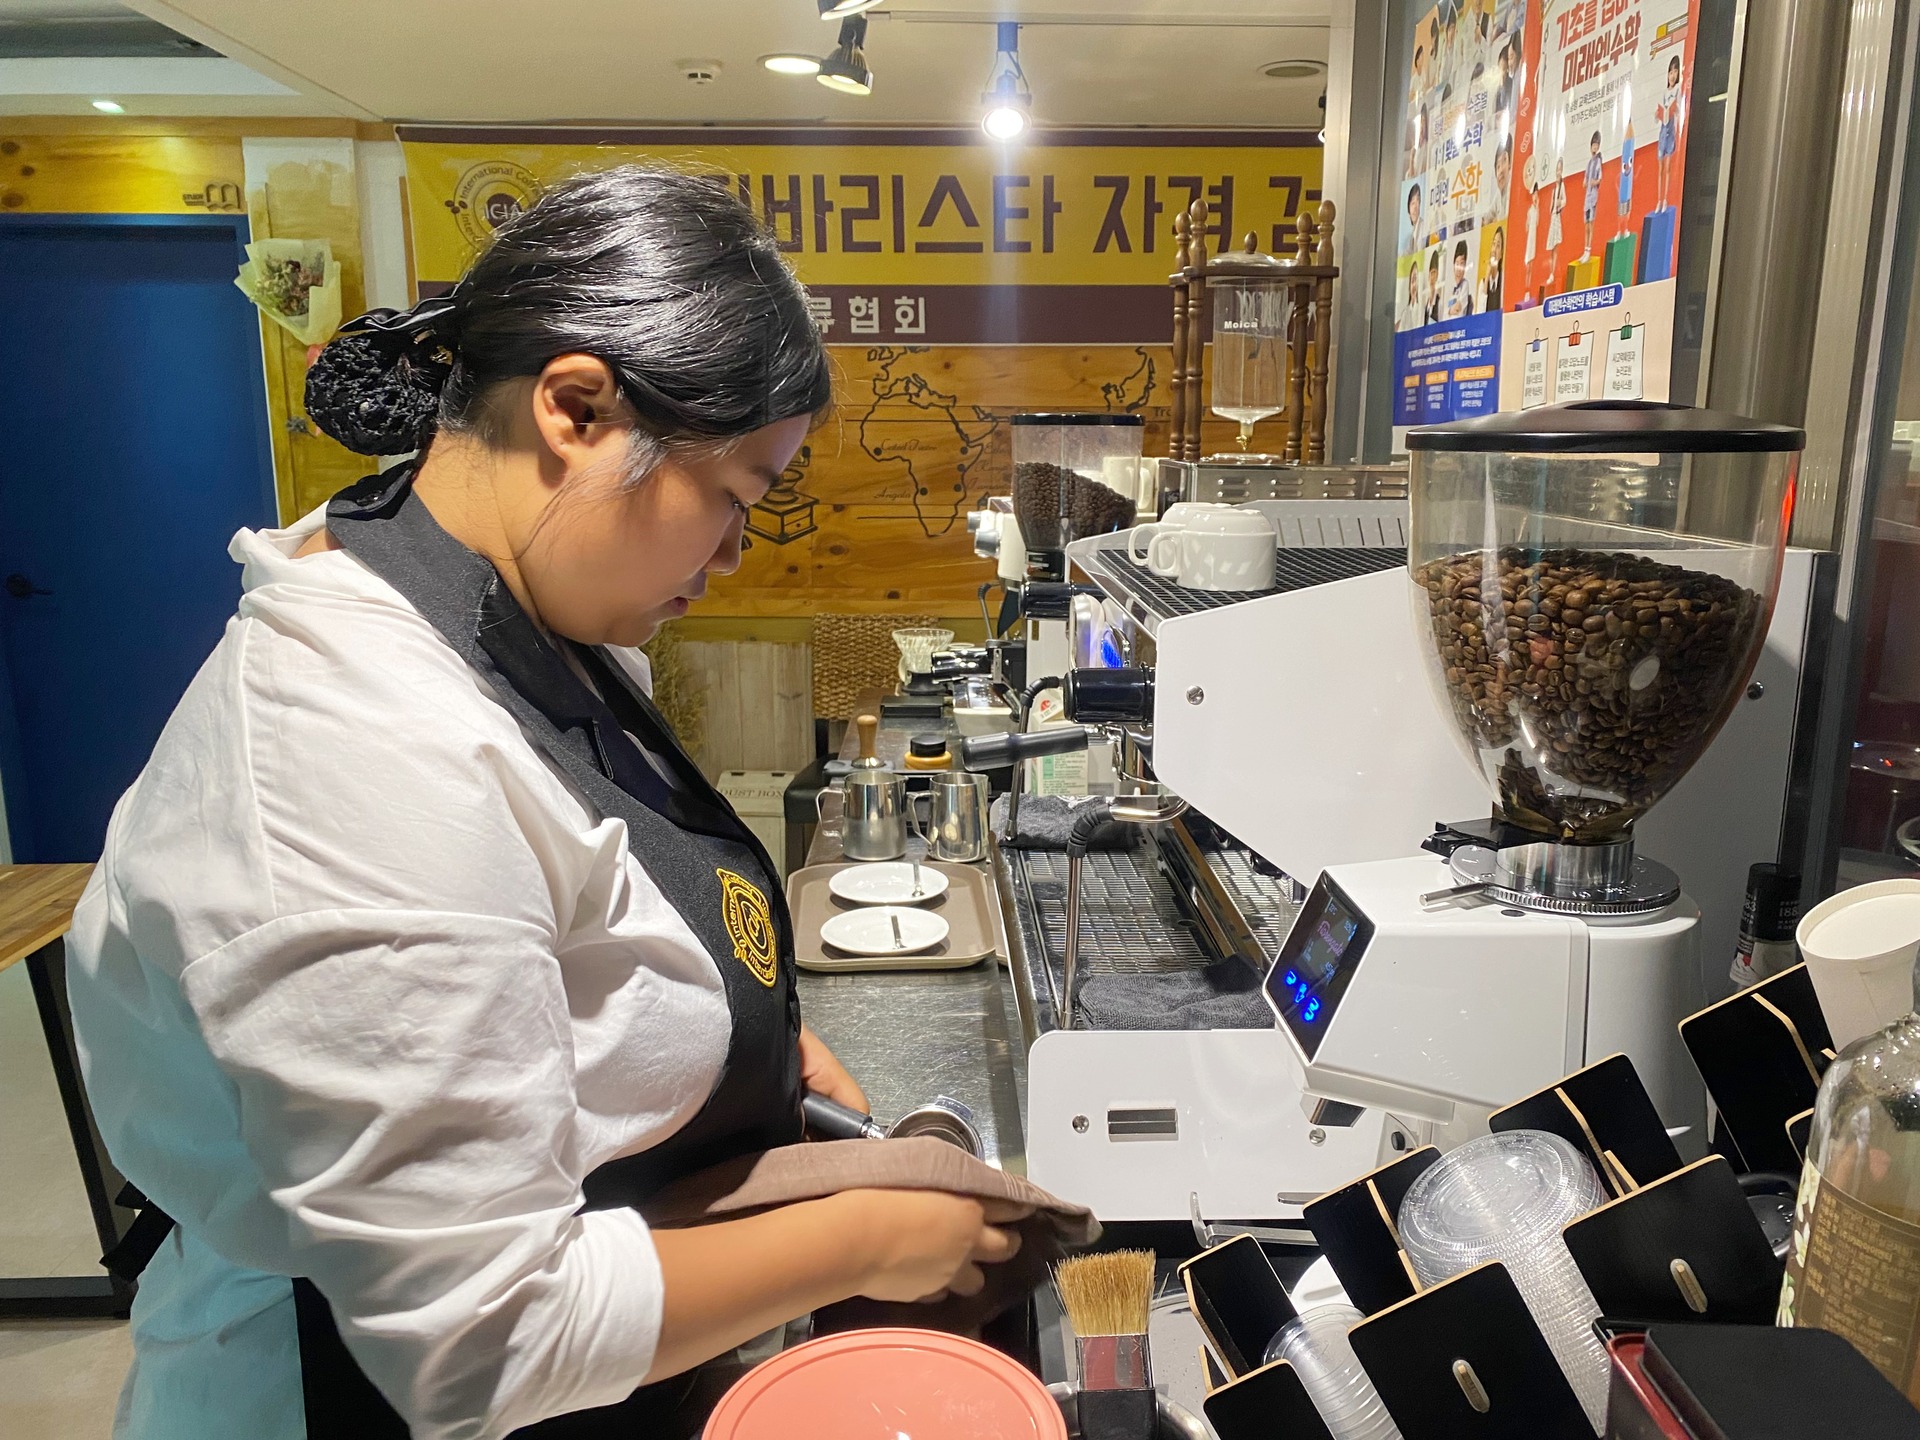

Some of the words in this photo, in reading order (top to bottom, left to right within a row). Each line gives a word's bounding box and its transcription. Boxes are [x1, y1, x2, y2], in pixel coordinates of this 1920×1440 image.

[1562, 11, 1641, 93] 미래엔수학
[1462, 121, 1484, 153] 수학
[460, 166, 513, 199] International
[1451, 161, 1483, 210] 수학
[700, 174, 1062, 253] 바리스타
